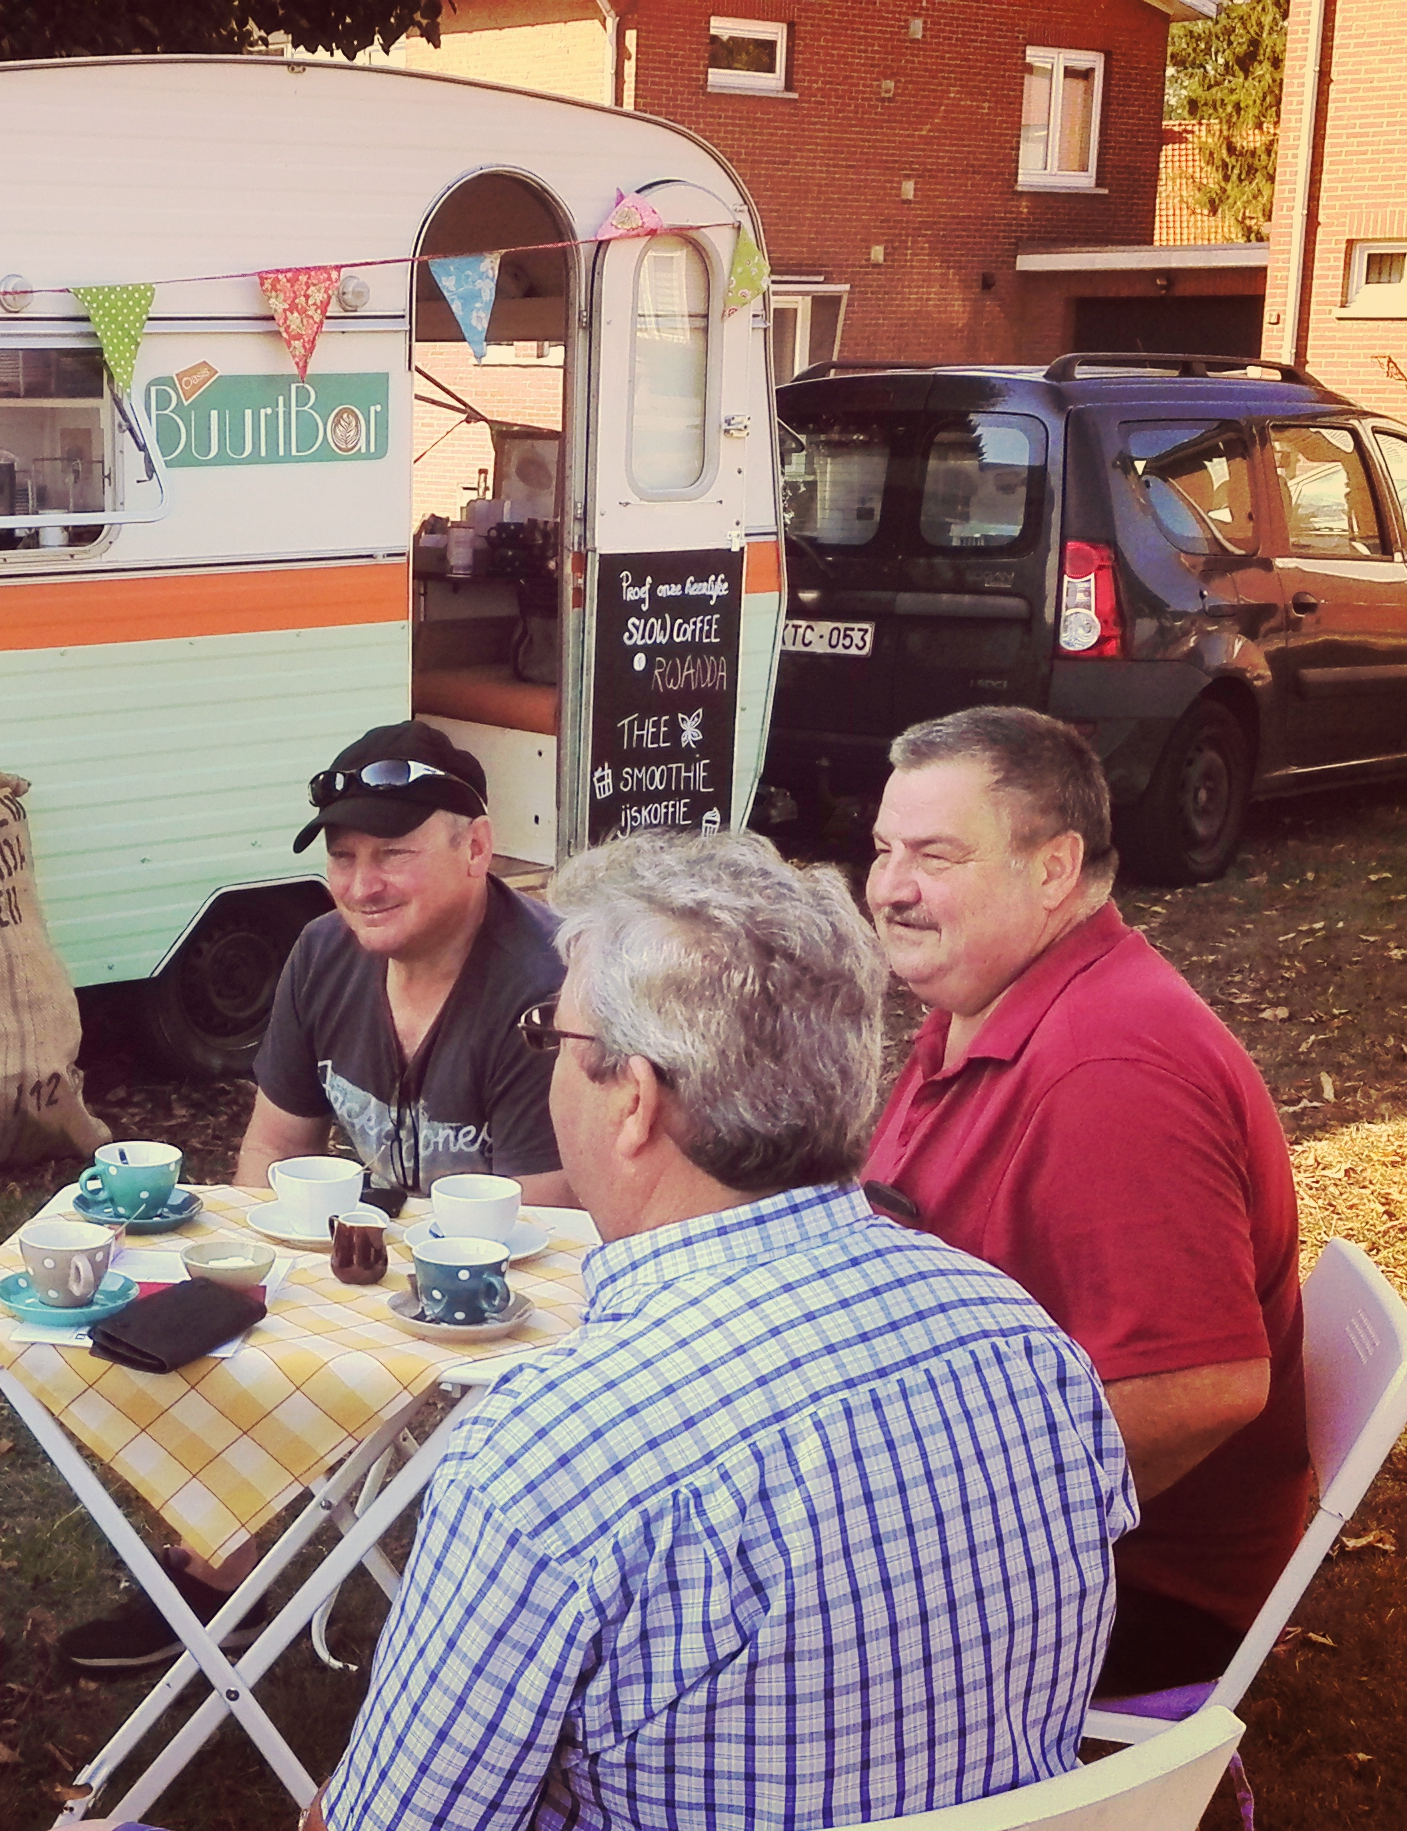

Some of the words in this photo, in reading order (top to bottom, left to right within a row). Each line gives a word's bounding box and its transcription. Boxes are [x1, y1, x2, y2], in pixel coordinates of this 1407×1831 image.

[149, 382, 382, 461] BuurtBar
[622, 612, 671, 645] SLOW
[651, 654, 728, 693] RWANDA
[616, 712, 672, 750] THEE
